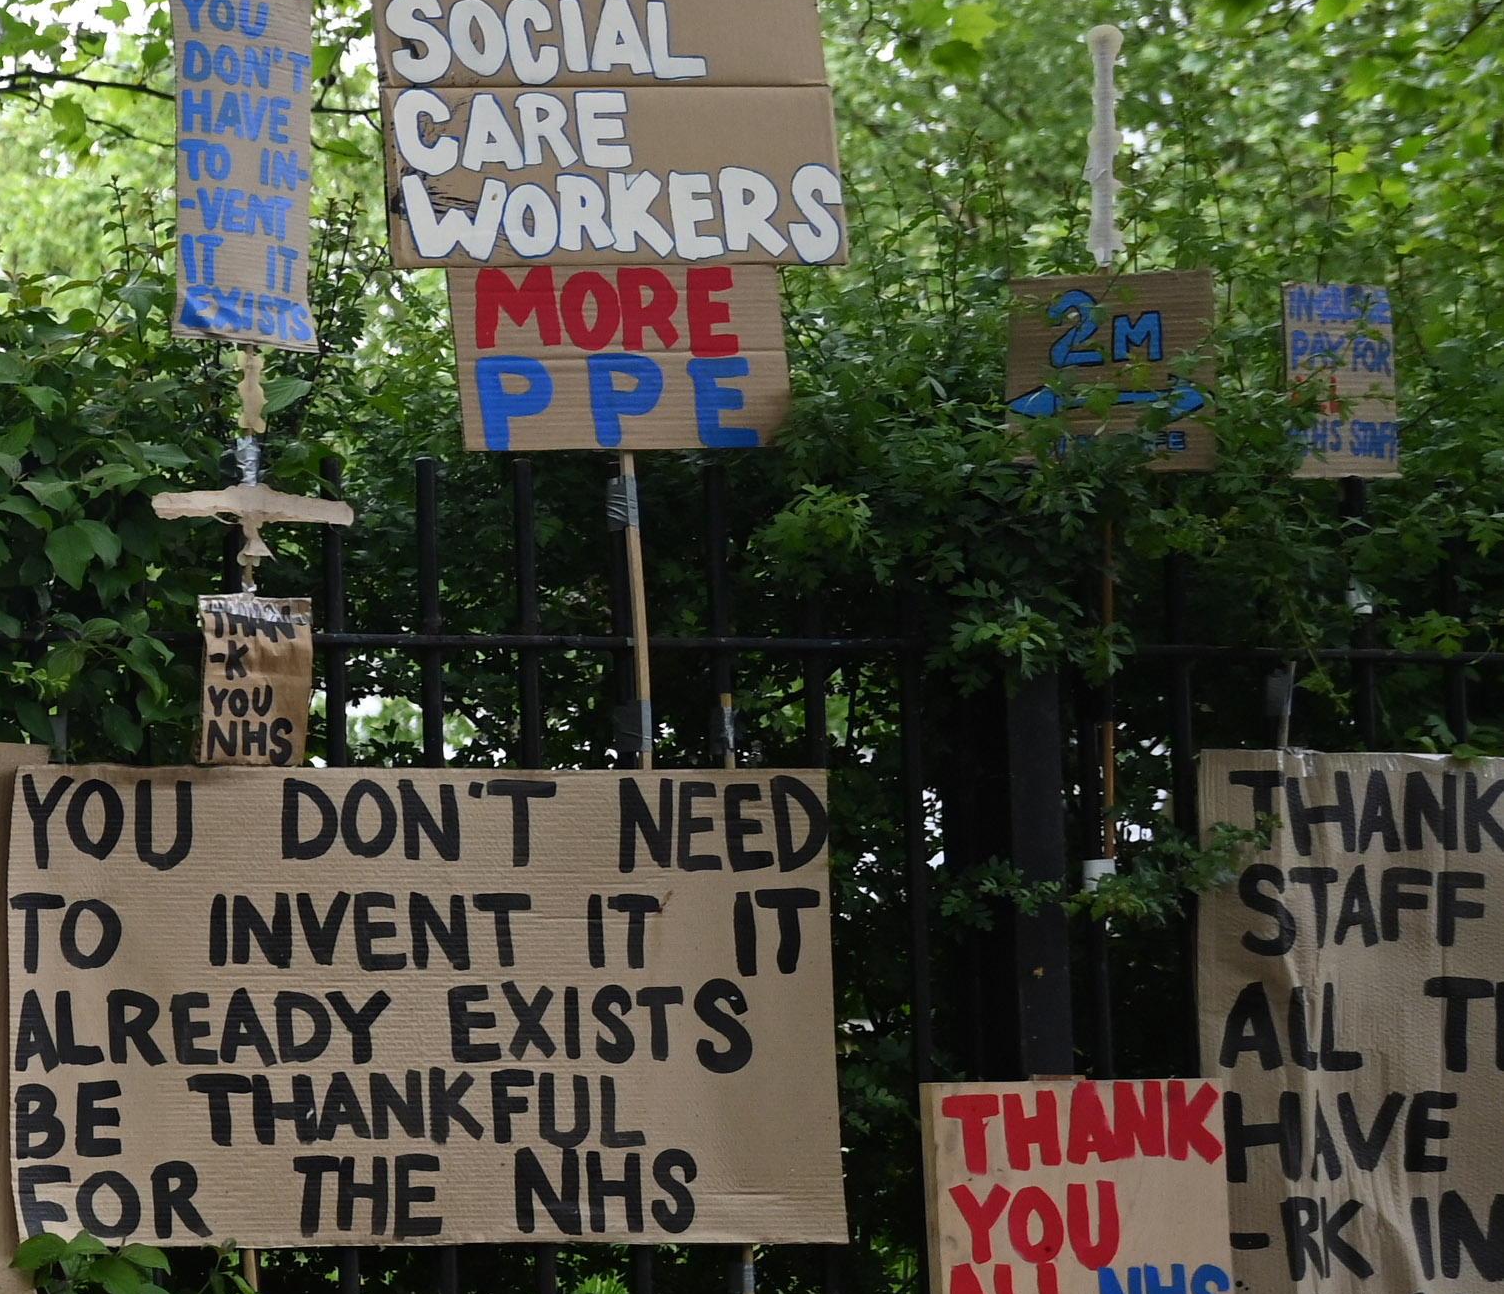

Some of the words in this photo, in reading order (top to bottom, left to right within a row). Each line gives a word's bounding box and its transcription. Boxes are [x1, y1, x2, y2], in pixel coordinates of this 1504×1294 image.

[182, 40, 311, 93] DON'T
[182, 89, 292, 145] HAVE
[393, 88, 634, 176] CARE
[400, 162, 843, 265] WORKERS
[180, 233, 224, 286] IT
[179, 284, 312, 341] EXISTS
[475, 265, 740, 357] MORE
[207, 718, 293, 766] NHS
[208, 685, 273, 717] YOU
[22, 774, 192, 870] YOU
[282, 777, 556, 868] DON'T
[617, 774, 827, 873] NEED
[9, 892, 122, 973] TO
[209, 891, 532, 972] INVENT
[587, 892, 662, 969] IT
[731, 887, 820, 978] IT
[1239, 863, 1486, 956] STAFF
[13, 986, 391, 1072] ALREADY
[451, 978, 753, 1074] EXISTS
[1219, 981, 1364, 1072] ALL
[13, 1079, 123, 1159] BE
[187, 1066, 646, 1148] THANKFUL
[942, 1080, 1223, 1175] THANK
[293, 1152, 442, 1240] THE
[514, 1145, 698, 1236] NHS
[948, 1179, 1120, 1271] YOU
